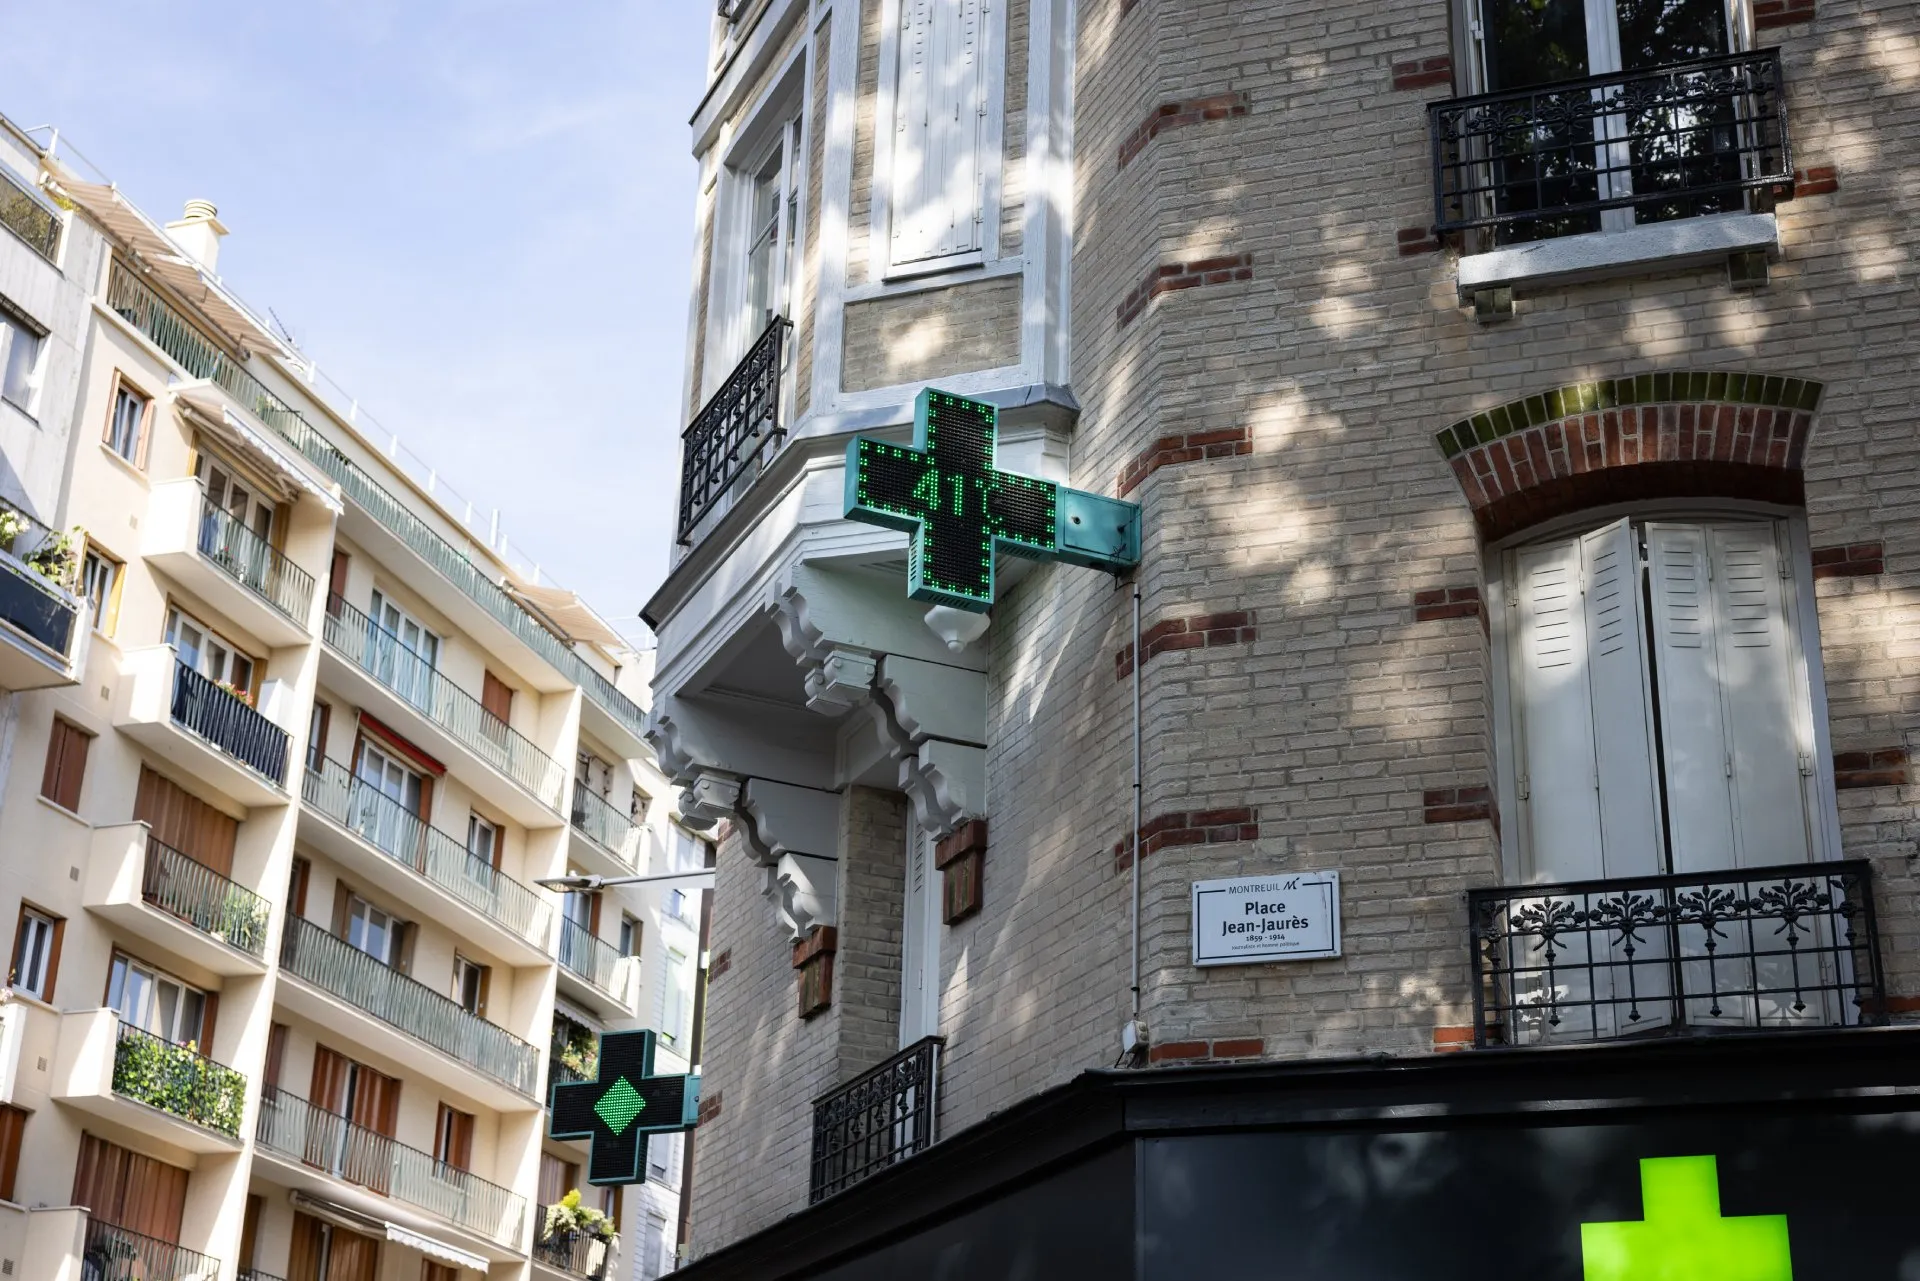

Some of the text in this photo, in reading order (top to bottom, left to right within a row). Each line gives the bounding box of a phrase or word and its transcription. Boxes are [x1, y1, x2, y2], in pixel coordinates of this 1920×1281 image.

[1229, 883, 1281, 894] MONTREUIL
[1245, 901, 1286, 915] Place
[1222, 915, 1309, 937] Jean-Jaurès
[1246, 934, 1263, 942] 1859
